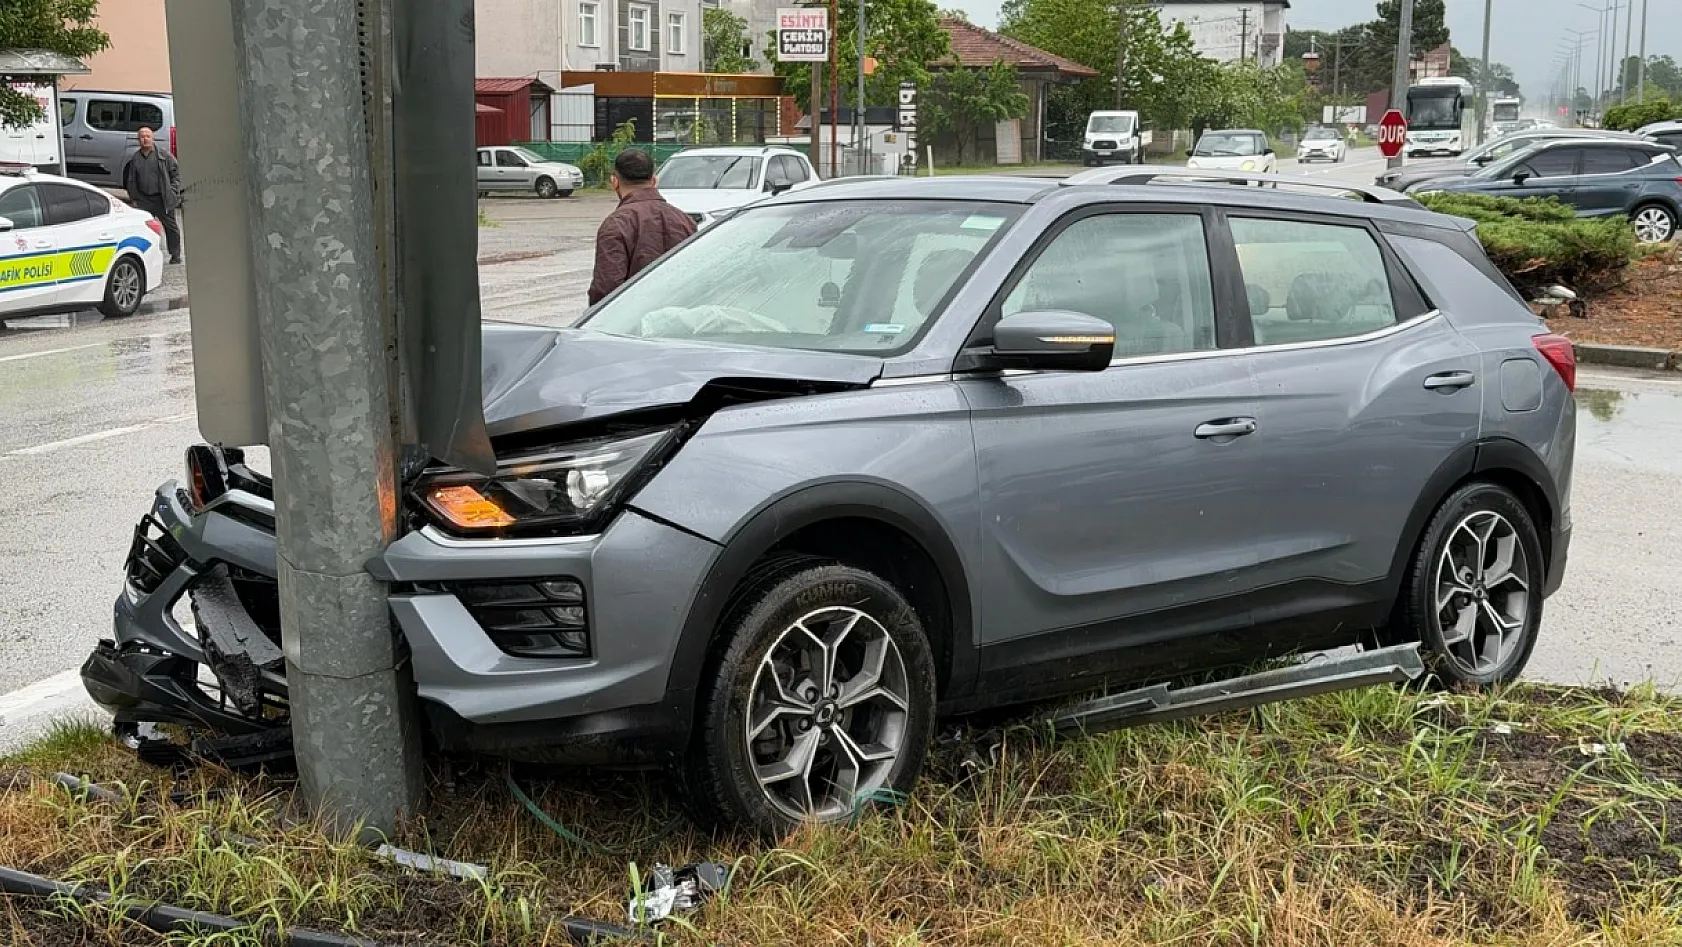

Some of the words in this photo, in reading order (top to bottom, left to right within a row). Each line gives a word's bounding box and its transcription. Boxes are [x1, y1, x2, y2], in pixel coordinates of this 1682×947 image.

[781, 11, 824, 28] ESİNTİ
[782, 30, 823, 43] ÇEKİM
[784, 43, 823, 53] PLATOSU
[1380, 125, 1405, 143] DUR
[23, 260, 53, 279] POLİSİ
